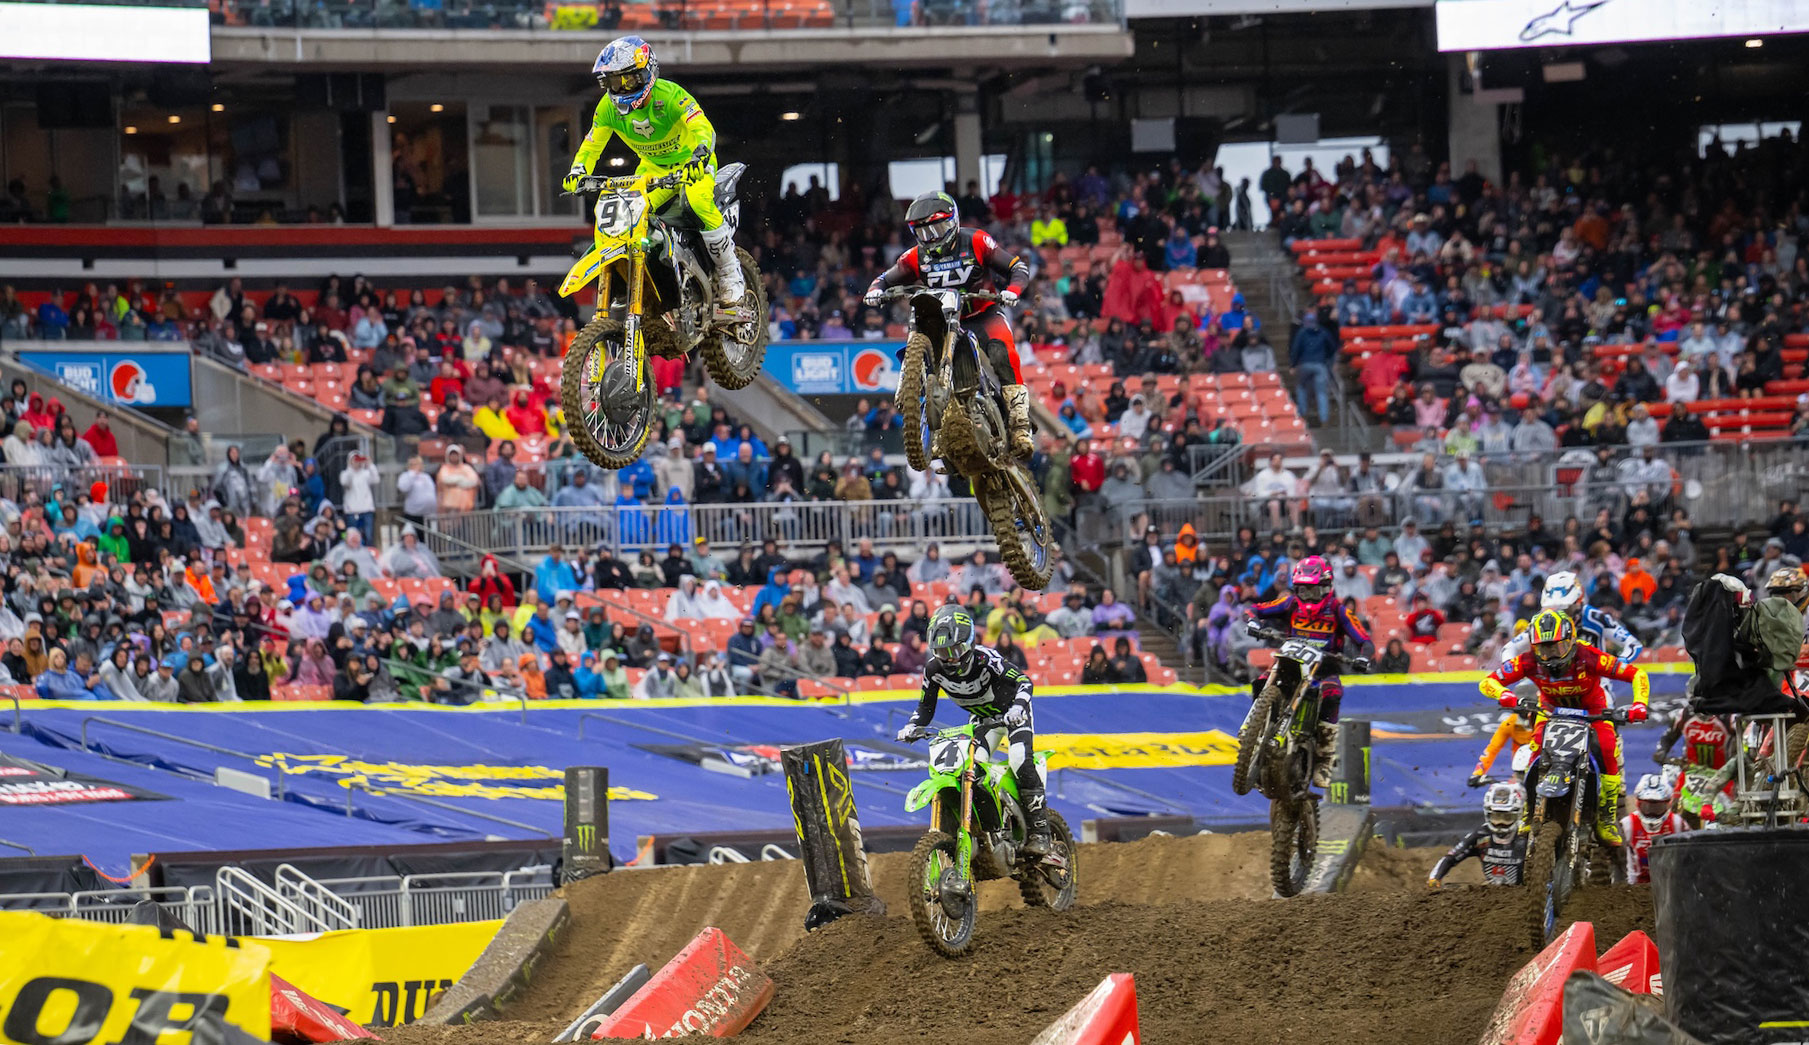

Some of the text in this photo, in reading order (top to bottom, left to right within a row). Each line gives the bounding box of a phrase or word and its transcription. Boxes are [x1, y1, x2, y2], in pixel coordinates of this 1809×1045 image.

[938, 260, 961, 271] YAMAHA
[927, 264, 975, 288] FLY
[1294, 616, 1334, 631] FXR
[1546, 724, 1586, 749] 32
[1688, 728, 1723, 742] FXR
[934, 743, 959, 768] 4
